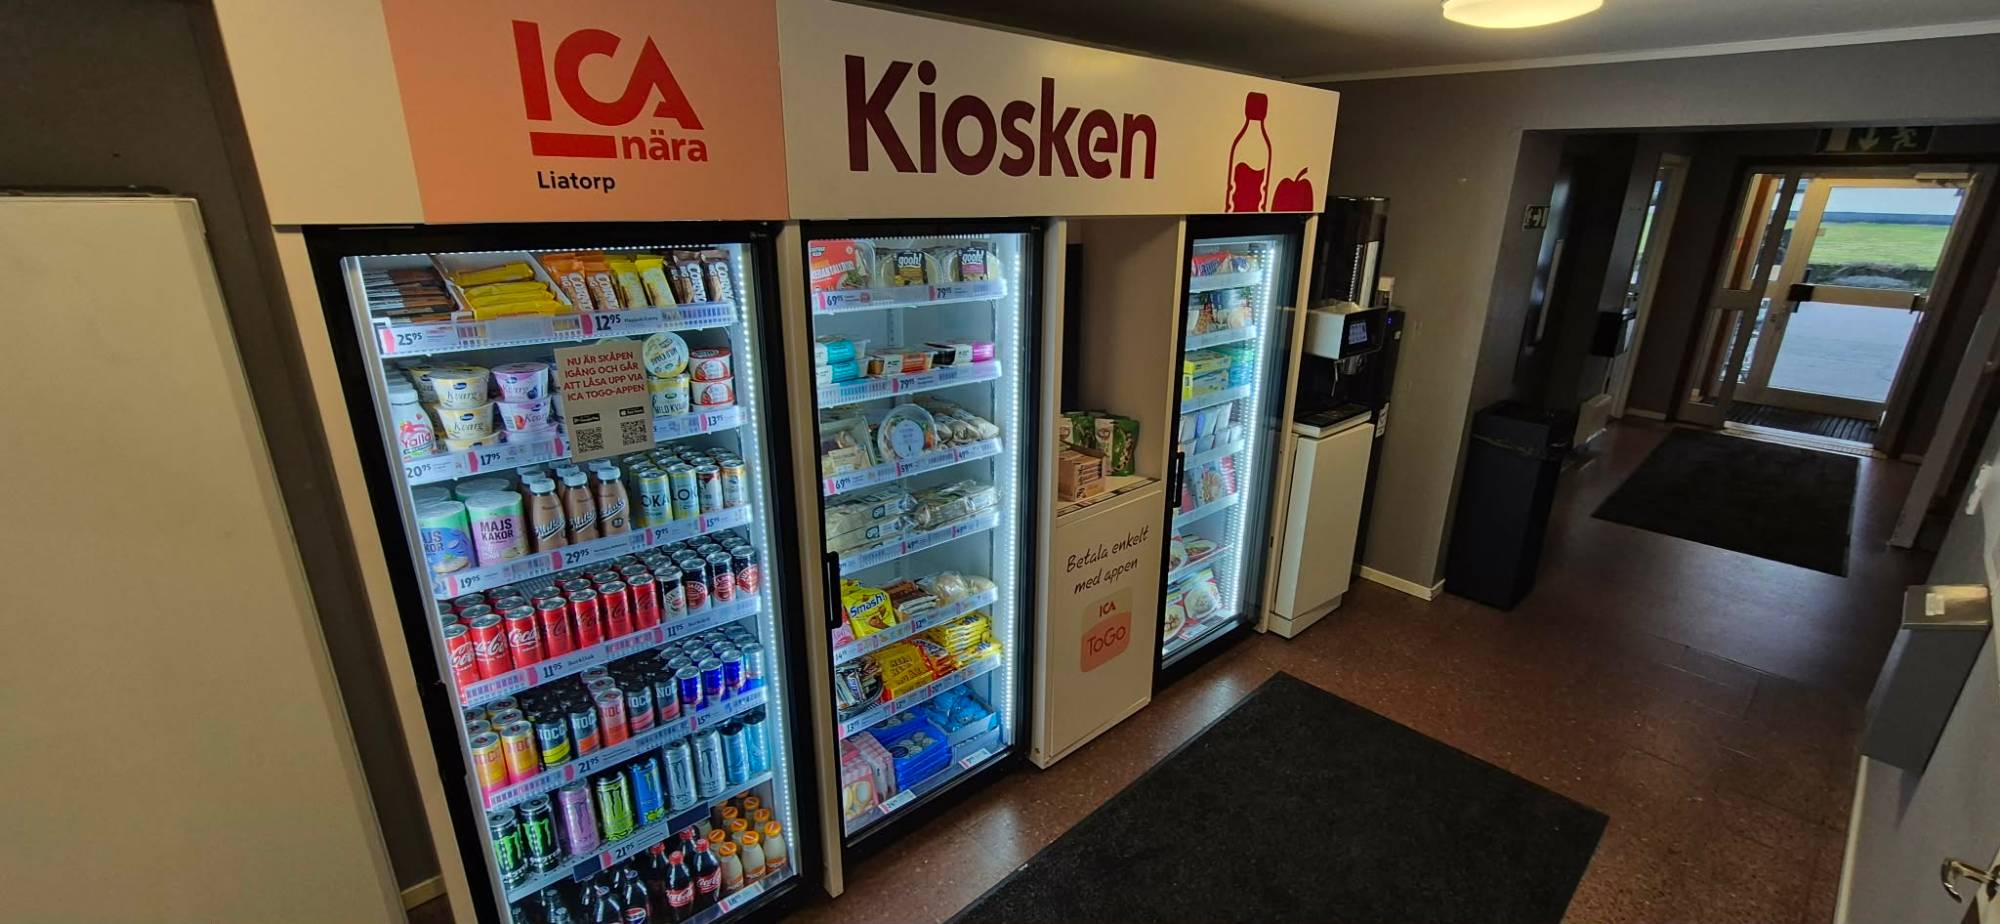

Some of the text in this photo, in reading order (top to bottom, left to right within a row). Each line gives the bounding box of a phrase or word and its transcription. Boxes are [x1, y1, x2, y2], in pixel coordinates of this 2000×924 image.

[512, 20, 704, 130] ICA
[845, 54, 1157, 180] Kiosken
[621, 129, 708, 162] nära
[537, 170, 615, 193] Liatorp
[565, 362, 639, 378] IGÅNG OCH GÅR
[567, 351, 633, 366] NU ÄR SKÅPEN
[563, 373, 643, 390] ATT LÅSA UPP VIA
[567, 383, 645, 401] ICA TOGO-APPEN
[480, 518, 513, 533] MAJS
[481, 529, 514, 542] KAKOR
[1066, 525, 1149, 573] Betala enkelt
[1074, 558, 1138, 595] med appen
[850, 591, 889, 619] Smash!
[1099, 600, 1117, 617] ICA
[1087, 625, 1126, 657] ToGo
